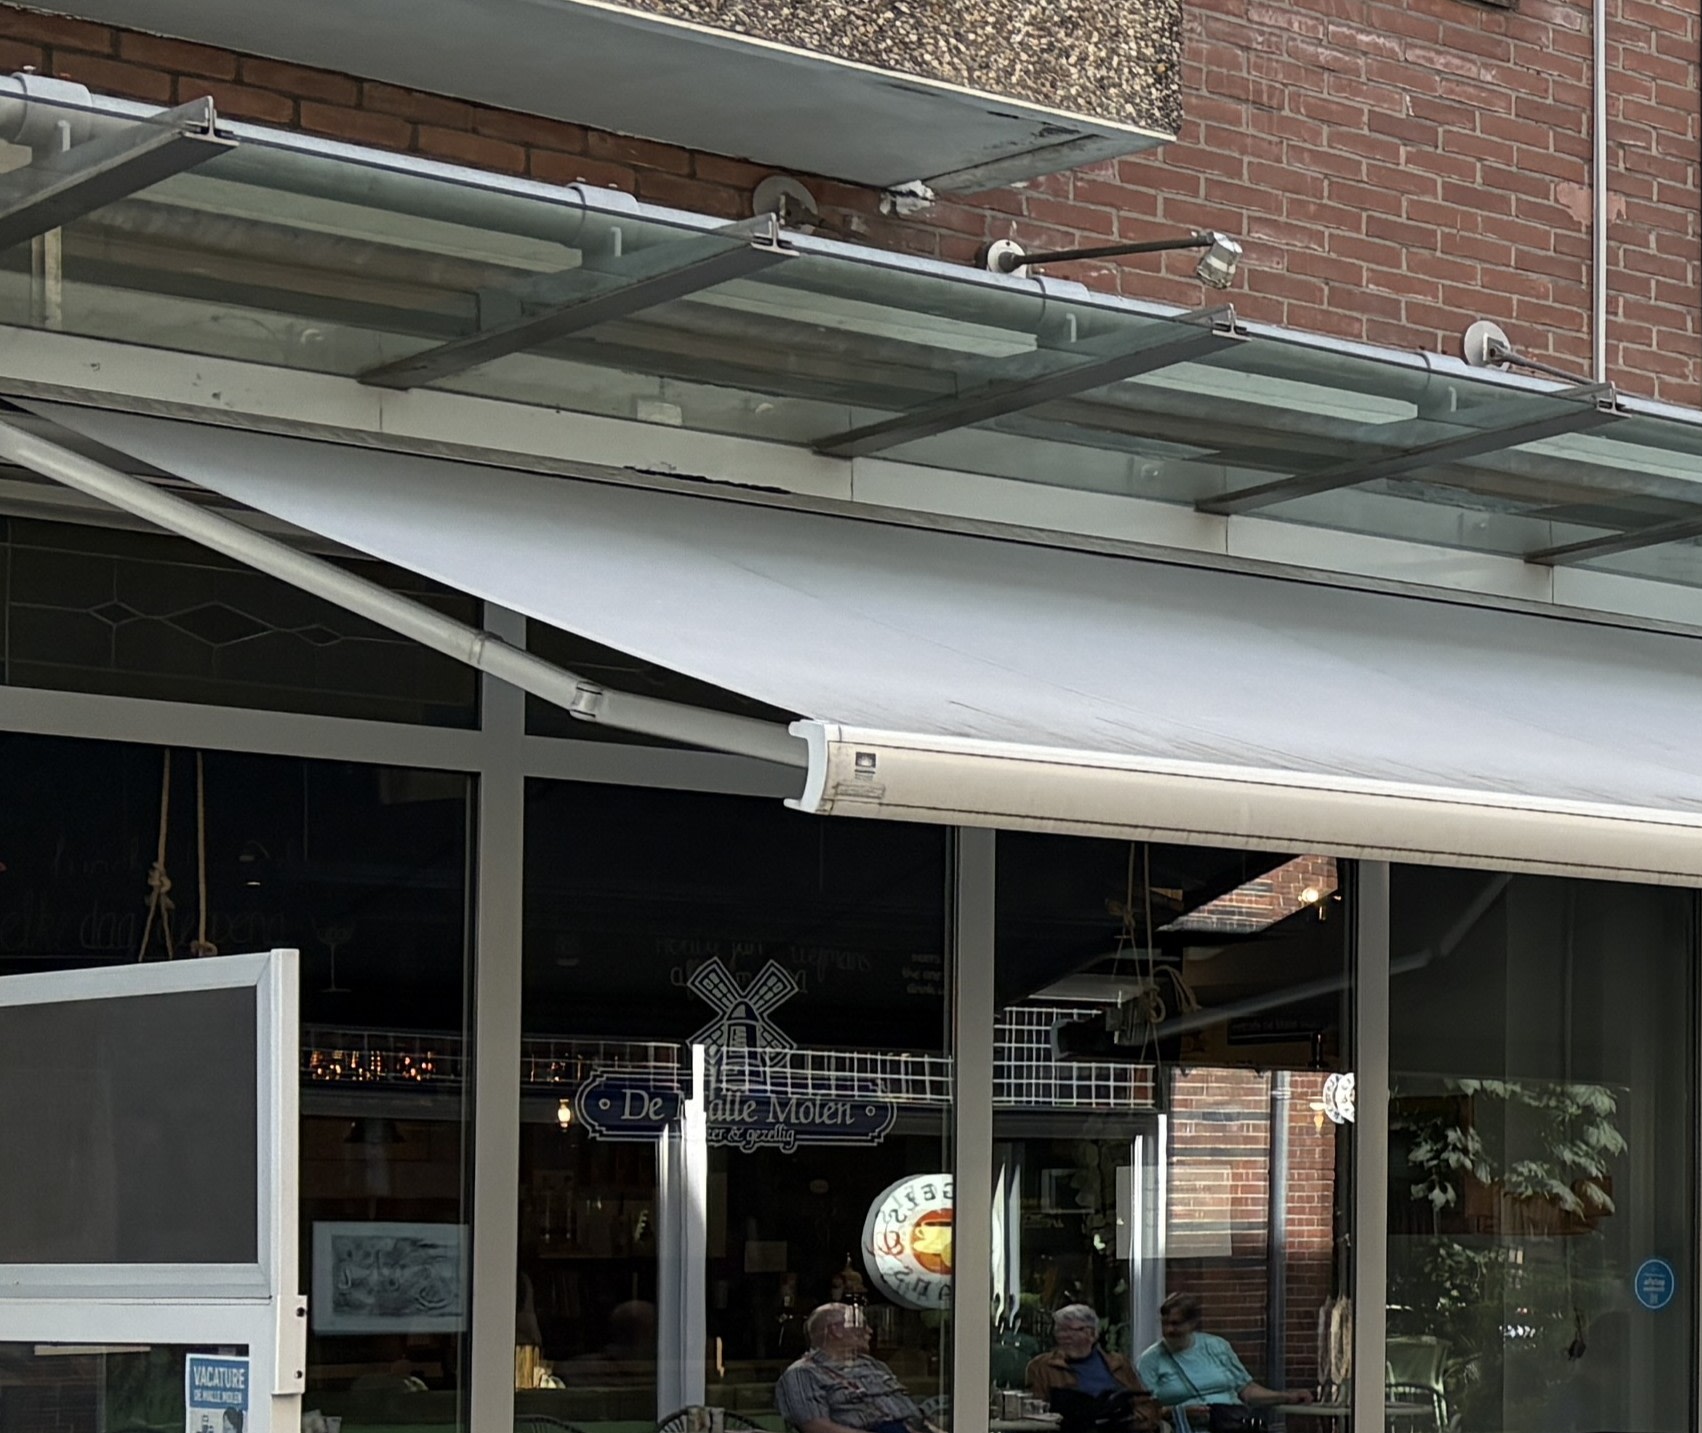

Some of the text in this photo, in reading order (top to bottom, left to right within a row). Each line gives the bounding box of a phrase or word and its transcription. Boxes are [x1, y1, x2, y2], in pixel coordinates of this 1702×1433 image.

[621, 1089, 665, 1121] De
[766, 1094, 855, 1125] Molen
[193, 1365, 245, 1388] VACATURE
